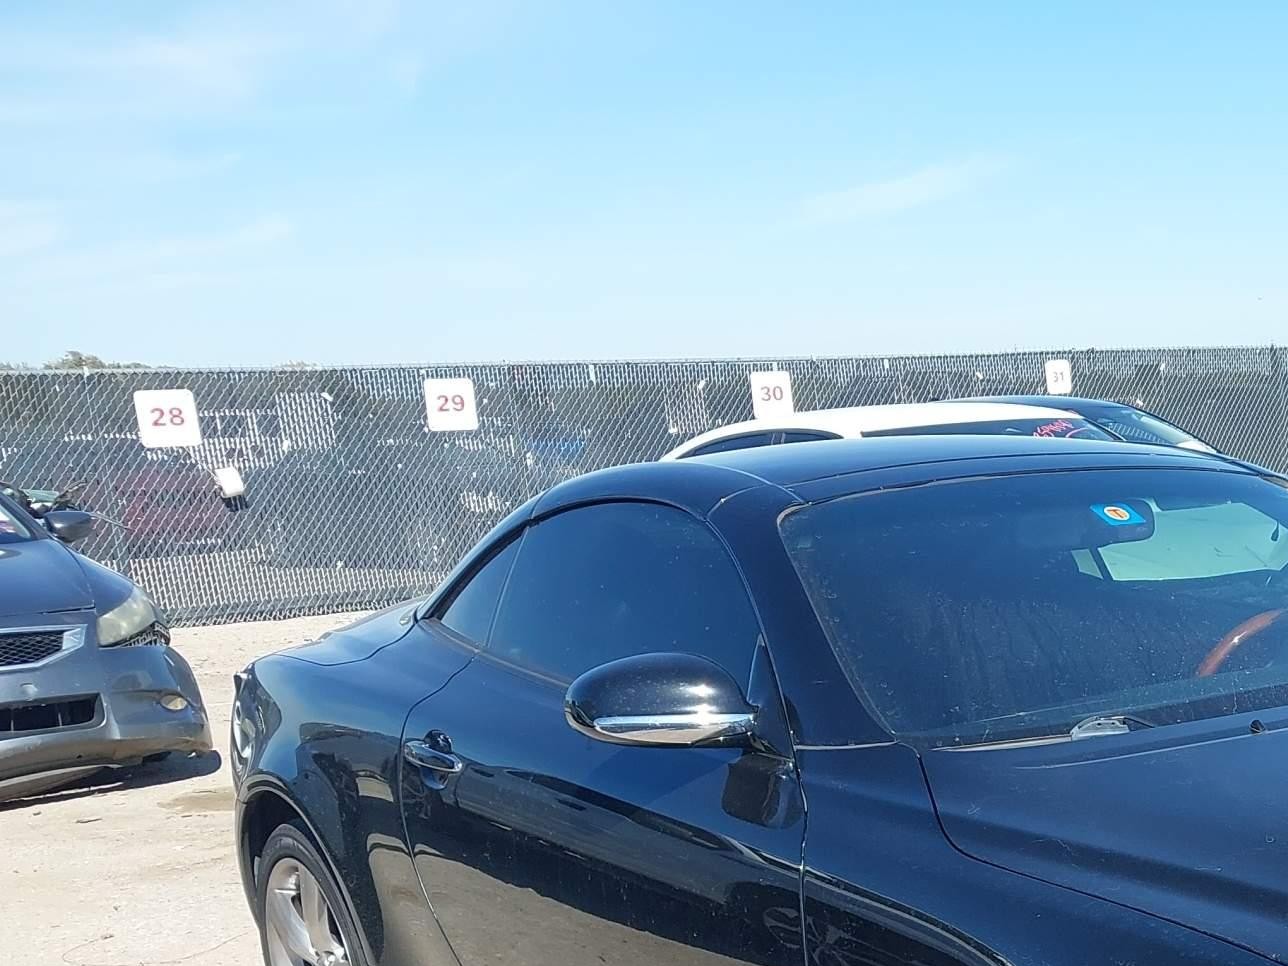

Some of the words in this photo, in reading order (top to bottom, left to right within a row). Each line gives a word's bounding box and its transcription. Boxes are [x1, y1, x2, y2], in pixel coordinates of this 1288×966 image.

[1052, 371, 1065, 383] 31
[760, 385, 784, 401] 30
[436, 394, 465, 412] 29
[150, 407, 185, 427] 28
